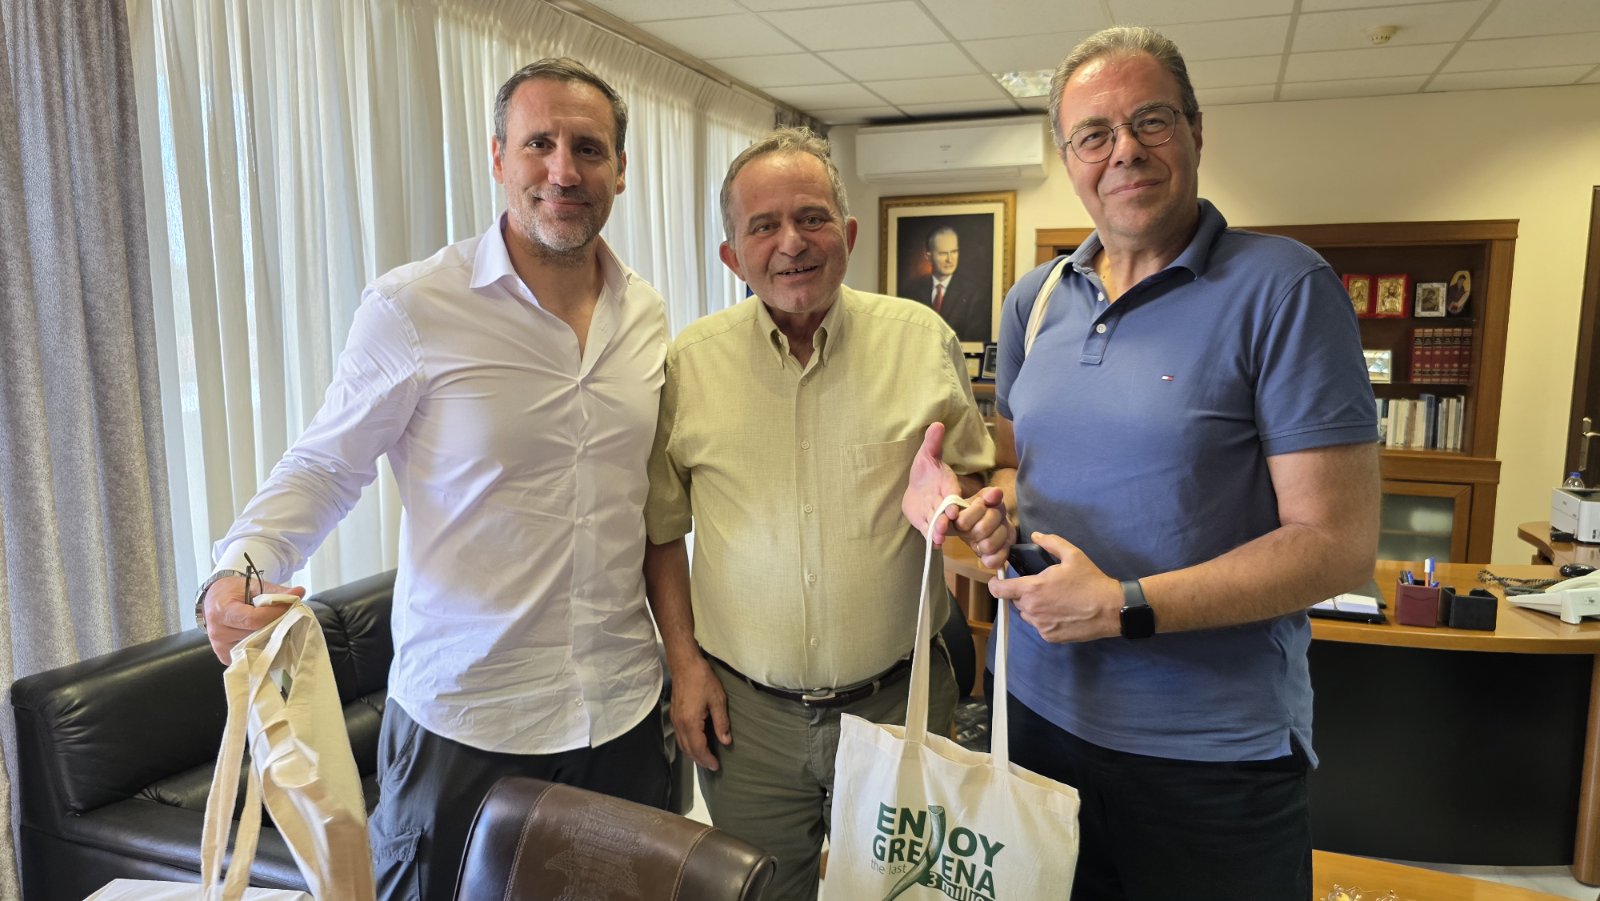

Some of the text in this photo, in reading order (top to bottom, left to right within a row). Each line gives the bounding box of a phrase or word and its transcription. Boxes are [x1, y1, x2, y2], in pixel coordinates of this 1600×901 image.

[870, 859, 885, 874] the
[888, 864, 907, 875] last
[927, 872, 938, 887] 3
